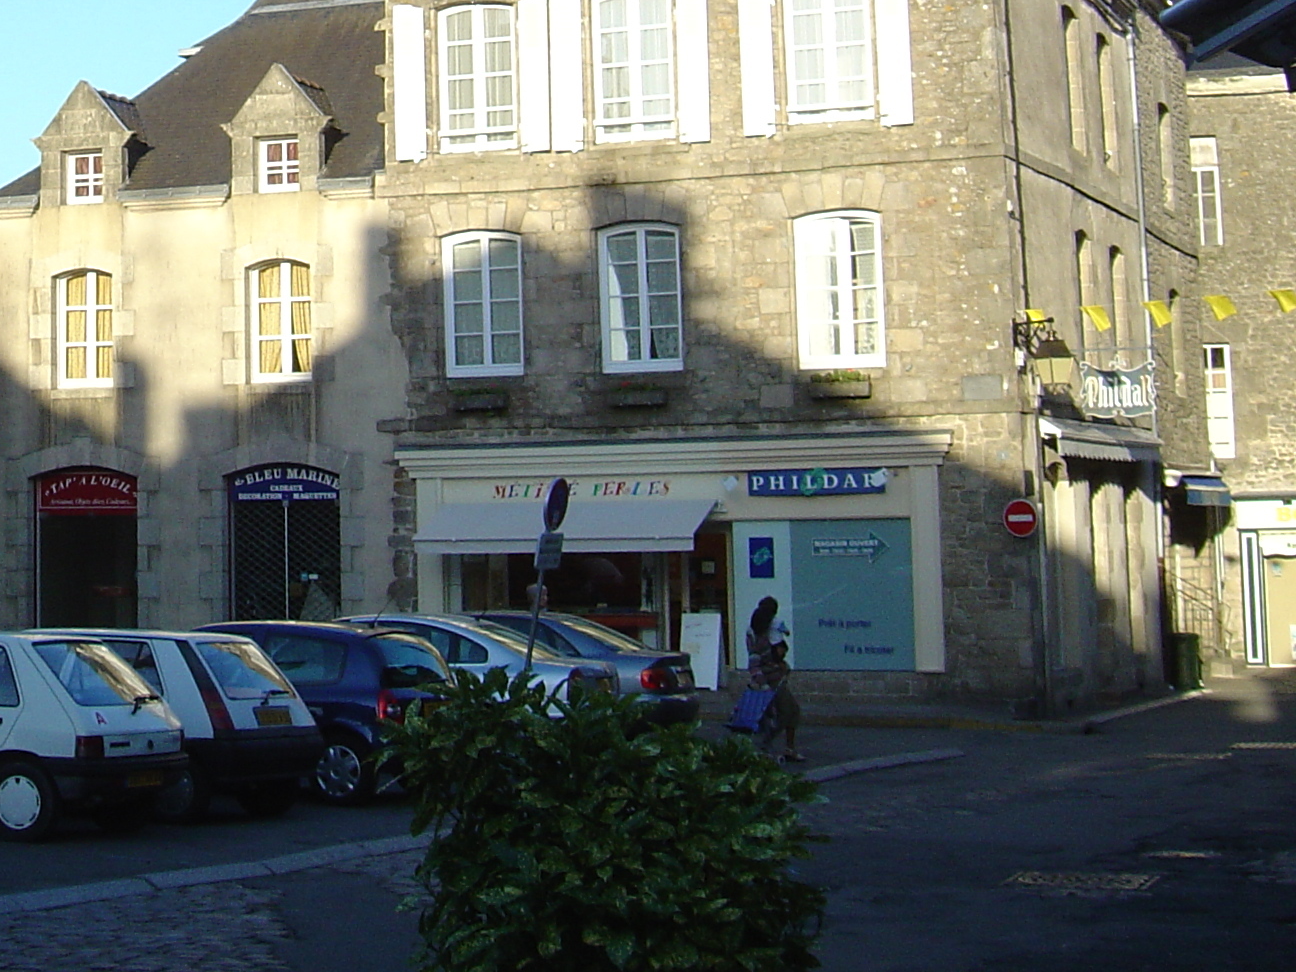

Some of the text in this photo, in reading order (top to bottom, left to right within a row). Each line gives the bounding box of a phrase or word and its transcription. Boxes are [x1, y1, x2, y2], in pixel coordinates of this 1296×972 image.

[245, 468, 341, 490] BLEU MARINE
[269, 484, 303, 492] CADEAUX
[95, 711, 107, 725] A
